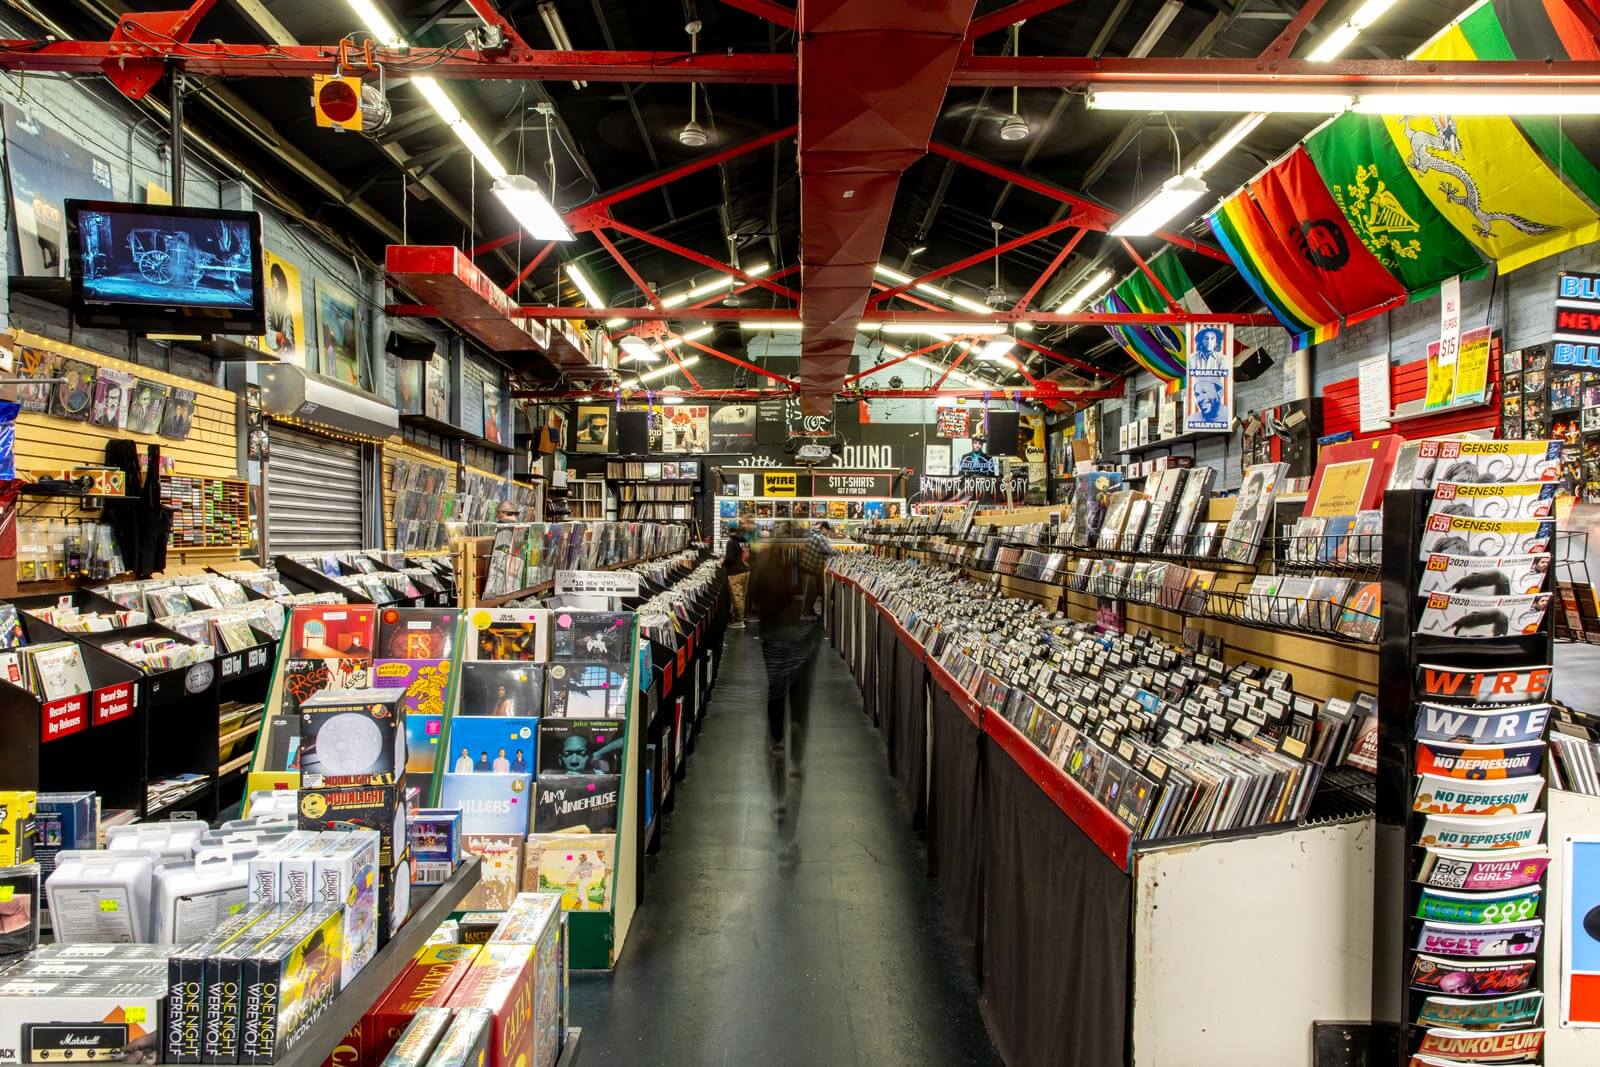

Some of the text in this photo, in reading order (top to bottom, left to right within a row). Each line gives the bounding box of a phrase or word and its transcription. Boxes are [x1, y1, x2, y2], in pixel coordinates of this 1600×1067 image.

[1441, 336, 1456, 357] $15
[1441, 443, 1509, 458] CD! GENESIS
[766, 476, 795, 485] WIRE
[829, 476, 875, 488] $11 T-SHIRTS
[964, 477, 997, 494] HORROR
[1000, 477, 1028, 494] SORY
[1436, 486, 1505, 499] CD! GENESIS
[1431, 519, 1502, 531] CD! GENESIS
[1429, 561, 1447, 571] CD!
[1448, 558, 1470, 567] 2020
[1430, 600, 1448, 610] CD!
[1449, 597, 1470, 607] 2020
[1424, 668, 1550, 695] WIRE
[101, 689, 128, 703] Record Store
[49, 702, 80, 718] Record Store
[100, 703, 128, 718] Day Releases
[49, 717, 81, 734] Day Releases
[1426, 709, 1548, 738] WIRE
[1433, 755, 1530, 771] NO DEPRESSION
[539, 788, 567, 806] AMY
[554, 790, 617, 815] WINEHOUSE
[1434, 790, 1529, 805] NO DEPRESSION
[1438, 829, 1532, 844] NO DEPRESSION
[1437, 863, 1467, 876] BIG
[1477, 861, 1520, 873] VIVIAN
[1473, 871, 1513, 881] GIRLS
[1426, 935, 1484, 949] UGLY
[169, 981, 184, 1056] WEREWOLF
[184, 982, 200, 1057] ONE NIGHT
[206, 981, 221, 1056] WEREWOLF
[221, 982, 238, 1057] ONE NIGHT
[244, 982, 260, 1057] WEREWOLF
[260, 983, 277, 1058] ONE NIGHT
[59, 1033, 101, 1046] Marshall
[1424, 1031, 1542, 1054] PUNKOLEUM
